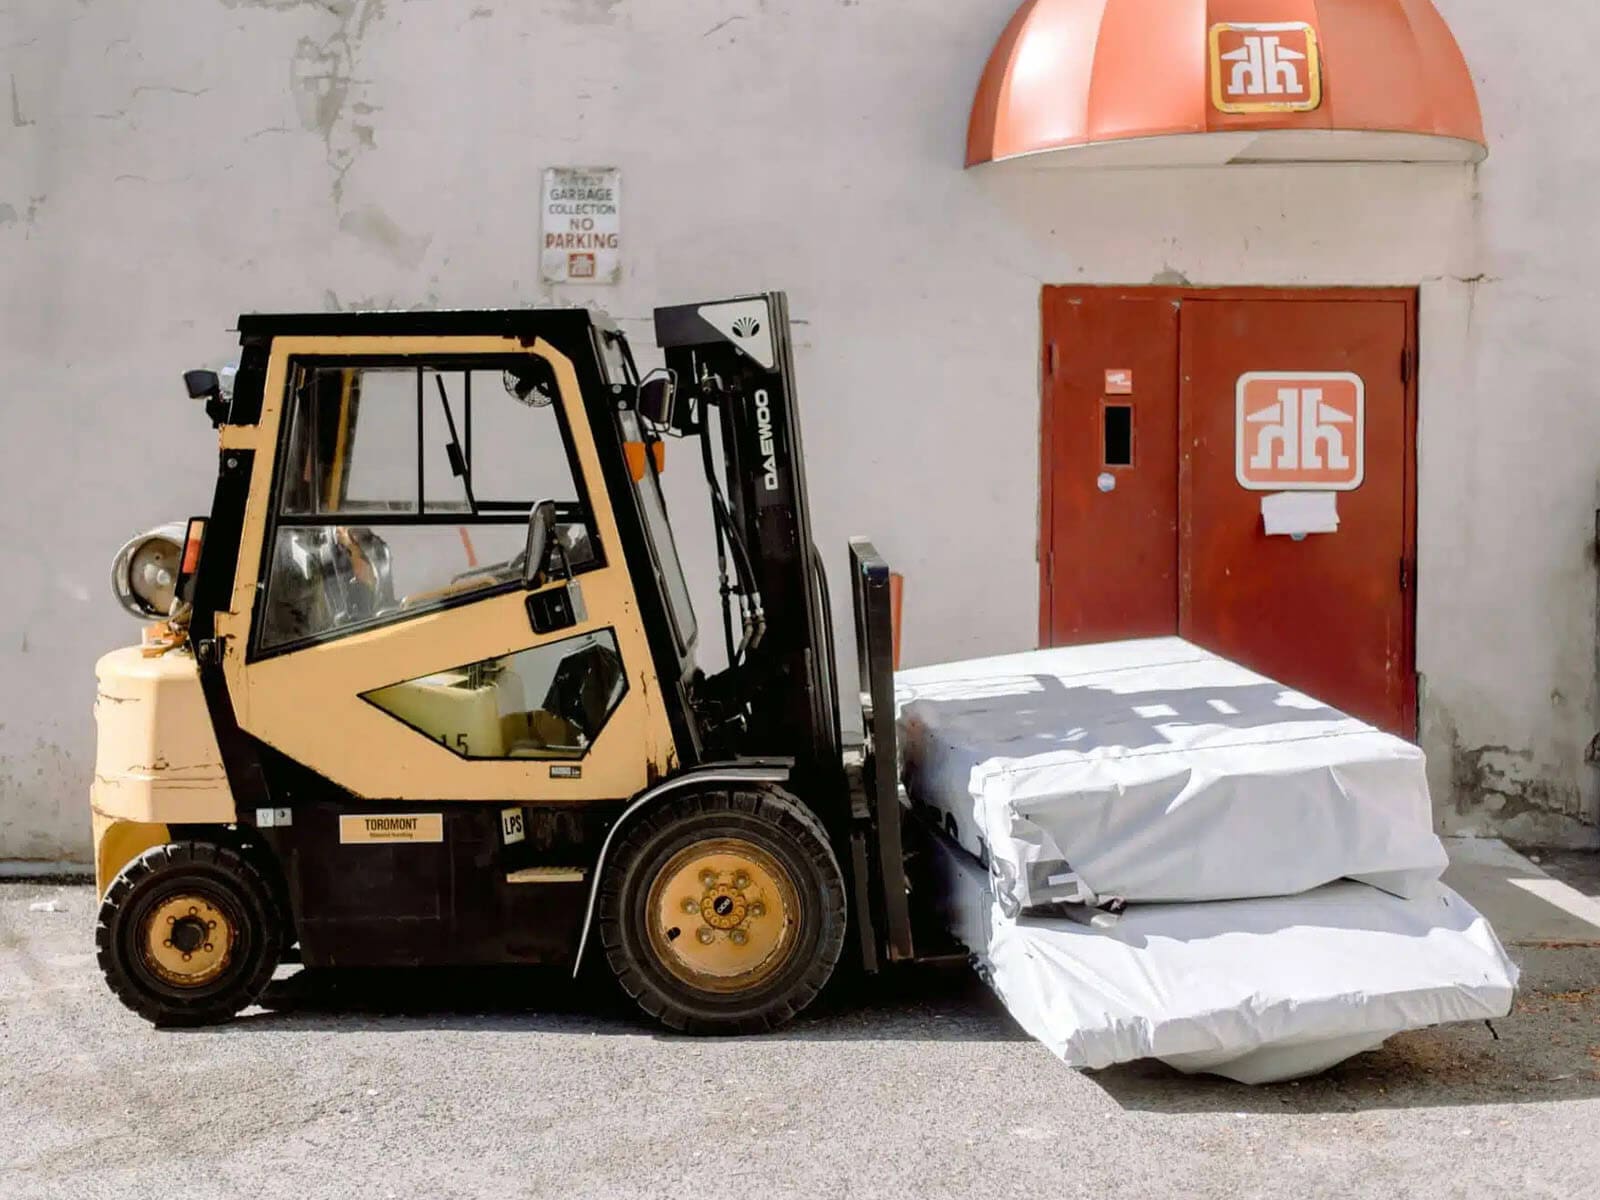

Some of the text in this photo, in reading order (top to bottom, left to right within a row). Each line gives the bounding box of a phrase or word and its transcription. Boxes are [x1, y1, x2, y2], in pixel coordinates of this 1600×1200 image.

[550, 188, 613, 201] GARBAGE
[548, 204, 616, 215] COLLECTION
[570, 218, 594, 231] NO
[545, 233, 618, 249] PARKING
[754, 388, 779, 491] DAEWOO
[365, 817, 418, 831] TOROMONT
[504, 814, 522, 835] LPS
